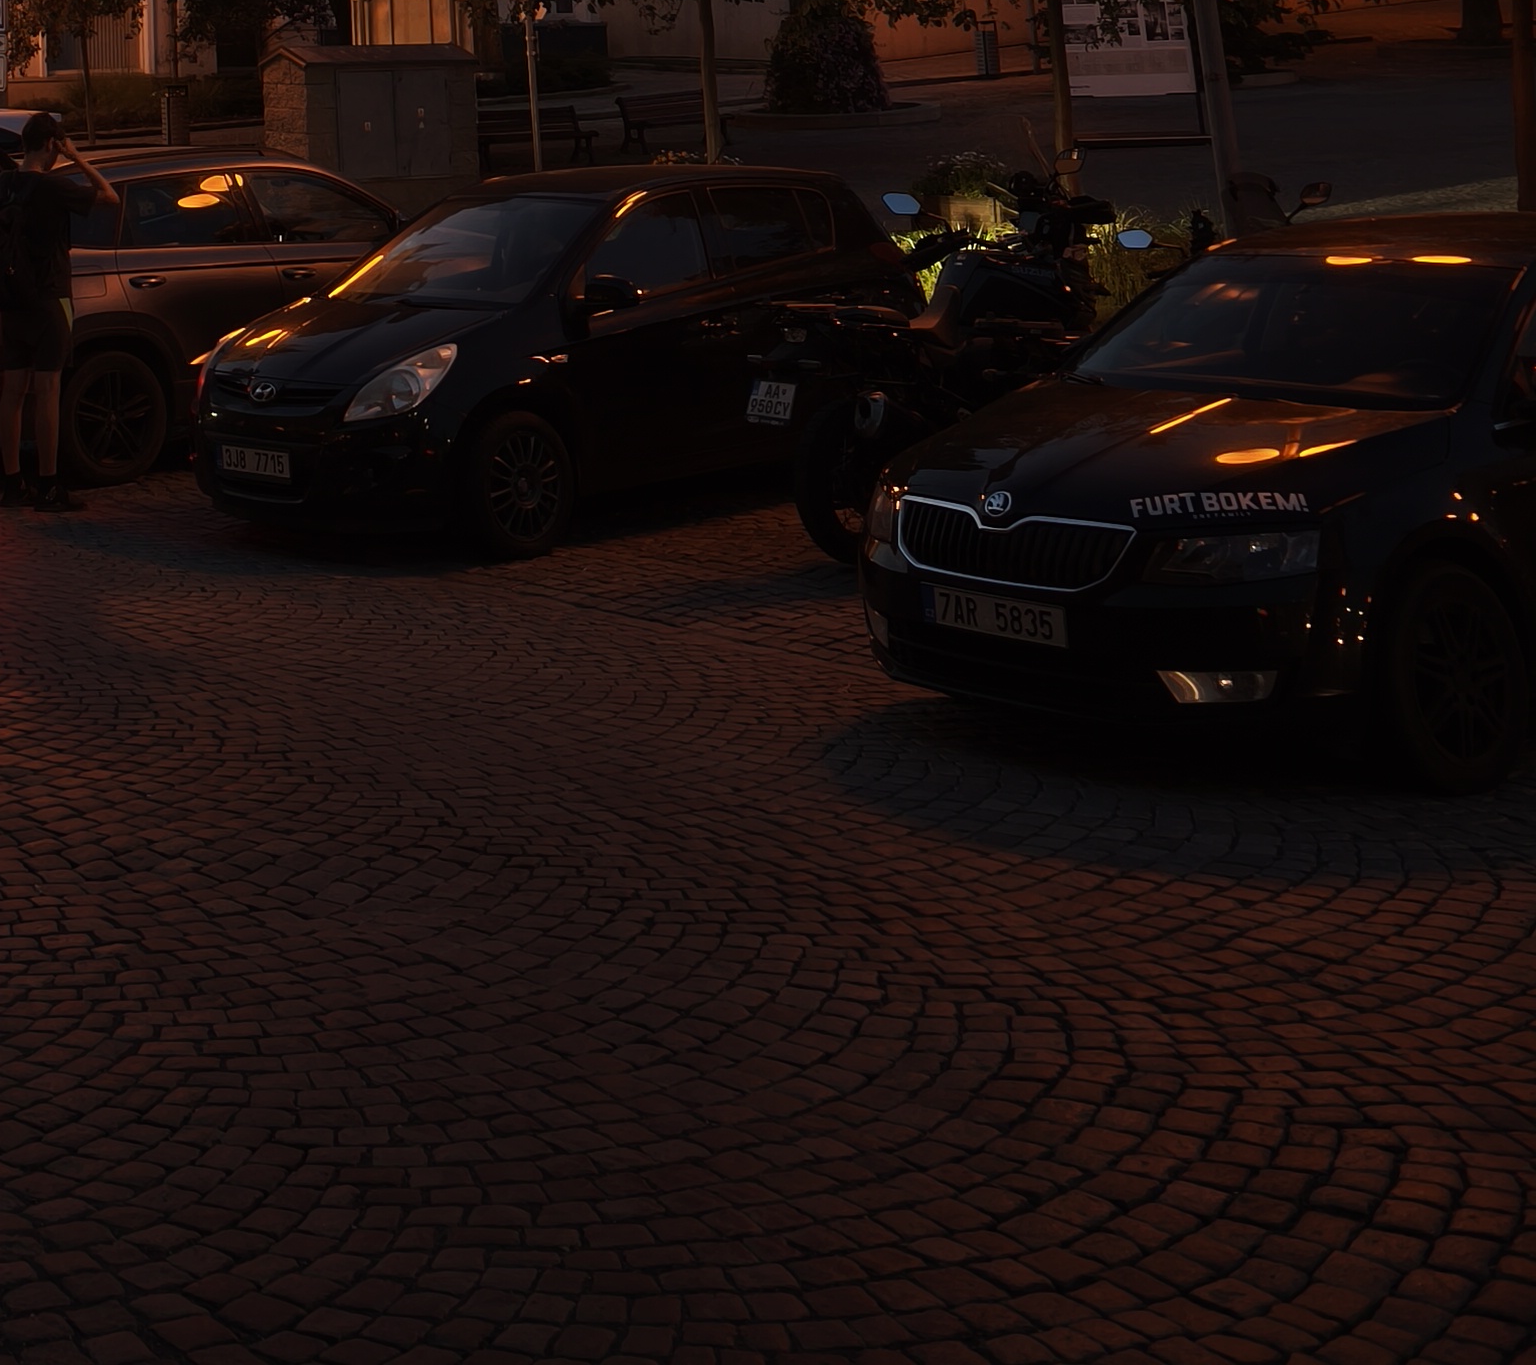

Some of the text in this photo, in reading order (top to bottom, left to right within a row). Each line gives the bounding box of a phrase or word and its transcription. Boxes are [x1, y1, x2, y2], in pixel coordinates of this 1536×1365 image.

[1010, 265, 1056, 280] SUZUKI
[764, 384, 780, 399] AA
[750, 398, 791, 417] 950CY
[225, 448, 284, 474] 3J8 7715
[1129, 492, 1310, 518] FURT BOKEM!
[938, 592, 979, 628] 7AR
[994, 602, 1053, 640] 5835
